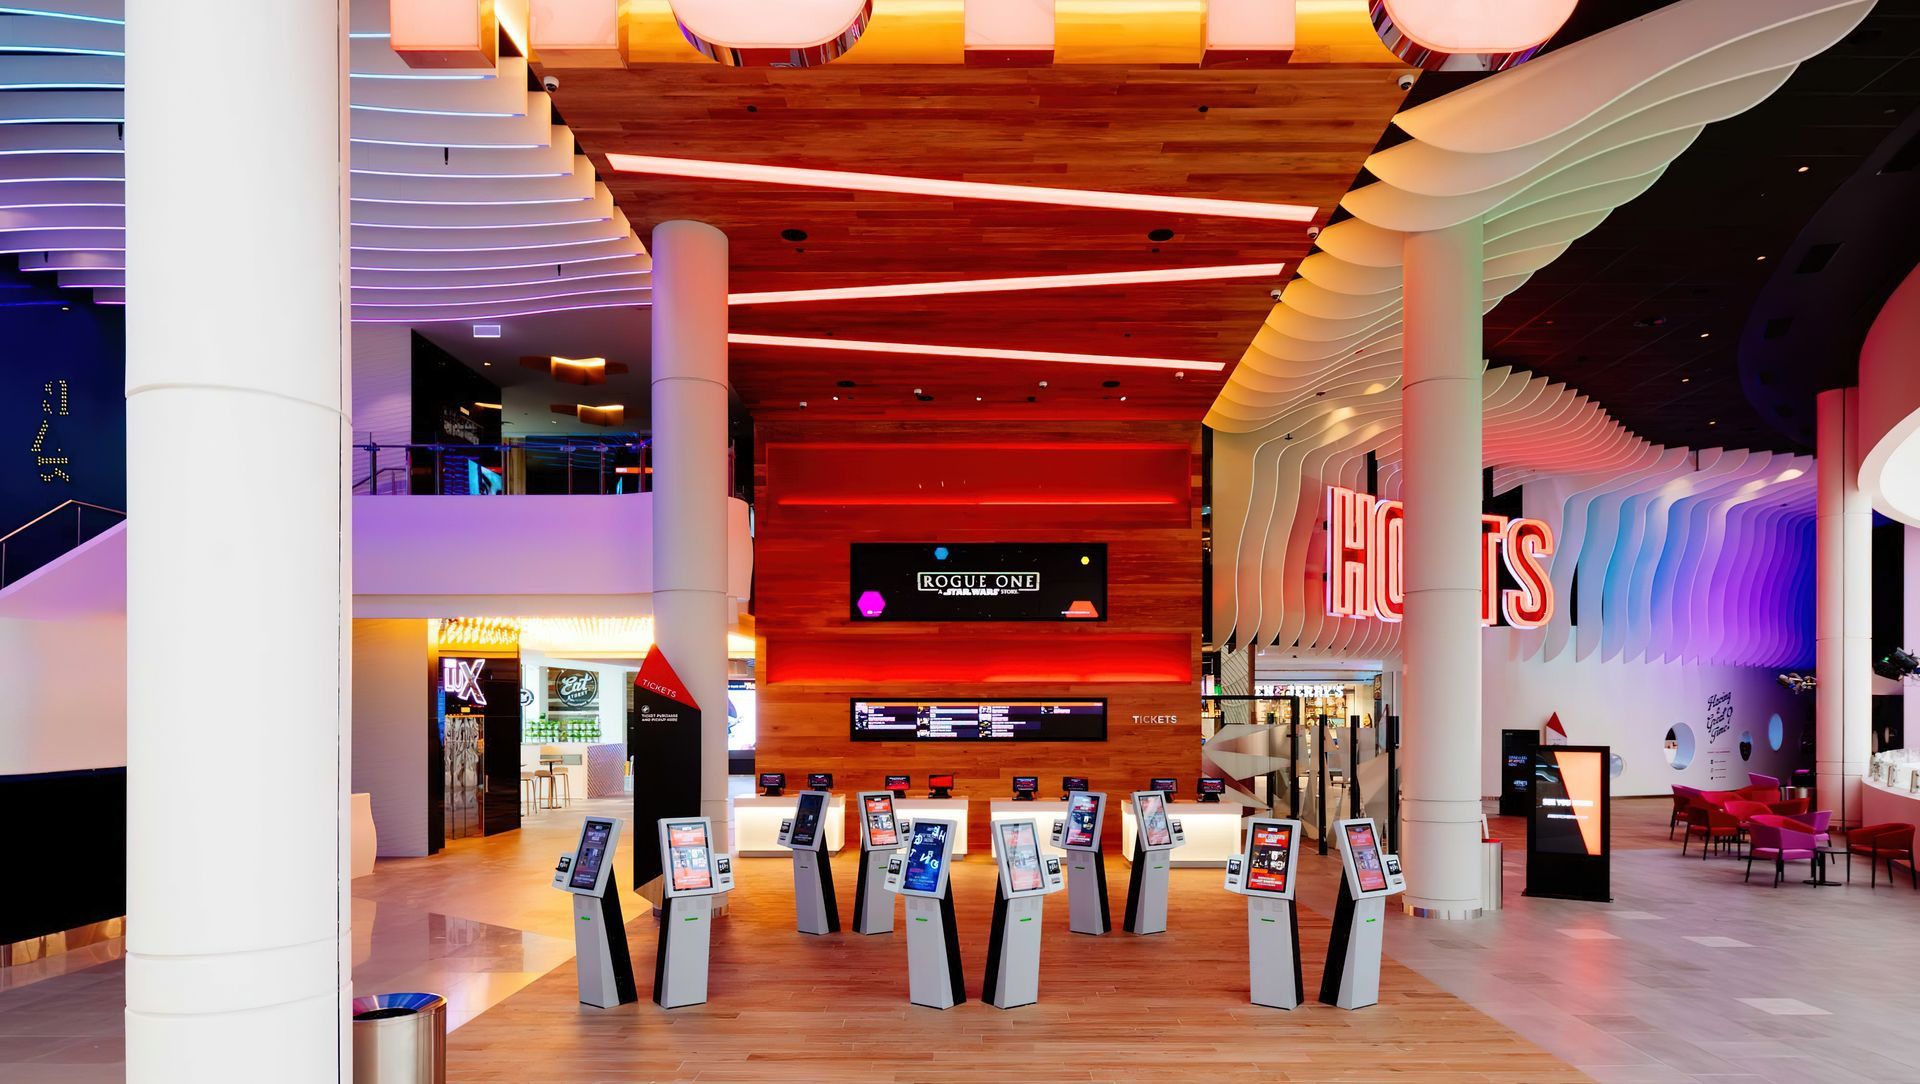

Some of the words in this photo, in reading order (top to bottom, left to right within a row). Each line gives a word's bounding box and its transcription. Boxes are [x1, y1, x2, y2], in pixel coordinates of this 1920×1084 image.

[1327, 485, 1554, 630] HOTS
[923, 575, 986, 588] ROGUE
[996, 575, 1034, 588] ONE
[943, 588, 972, 596] STAR
[971, 588, 1000, 596] WARS
[444, 658, 488, 706] LUX
[560, 673, 593, 696] Eat
[641, 679, 677, 698] TICKETS
[1707, 691, 1732, 712] Having
[1132, 715, 1177, 724] TICKETS
